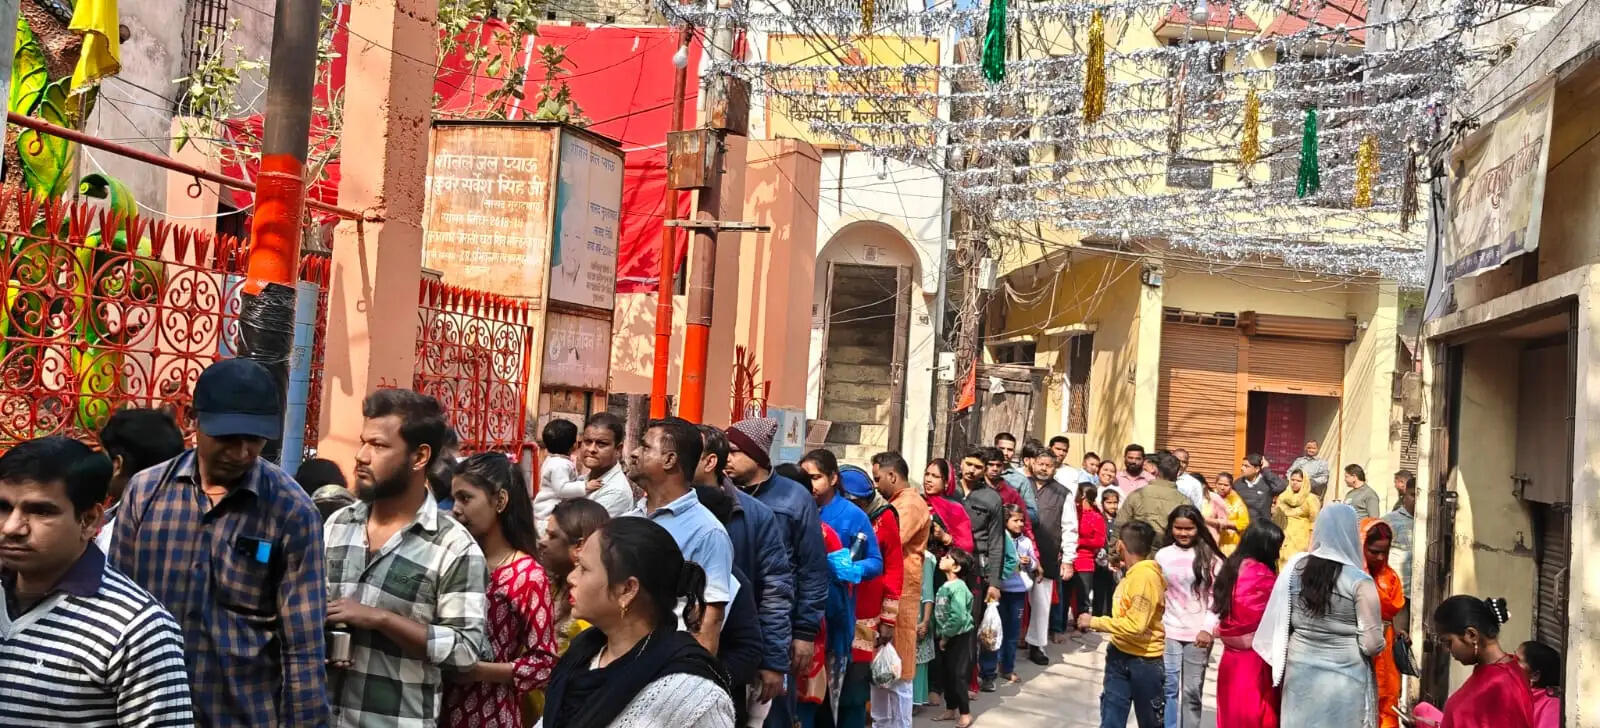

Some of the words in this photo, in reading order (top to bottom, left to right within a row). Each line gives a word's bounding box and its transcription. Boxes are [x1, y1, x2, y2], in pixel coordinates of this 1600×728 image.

[475, 155, 498, 171] जल
[501, 157, 538, 172] प्याऊ
[496, 174, 525, 195] सिंह
[527, 175, 547, 195] जी
